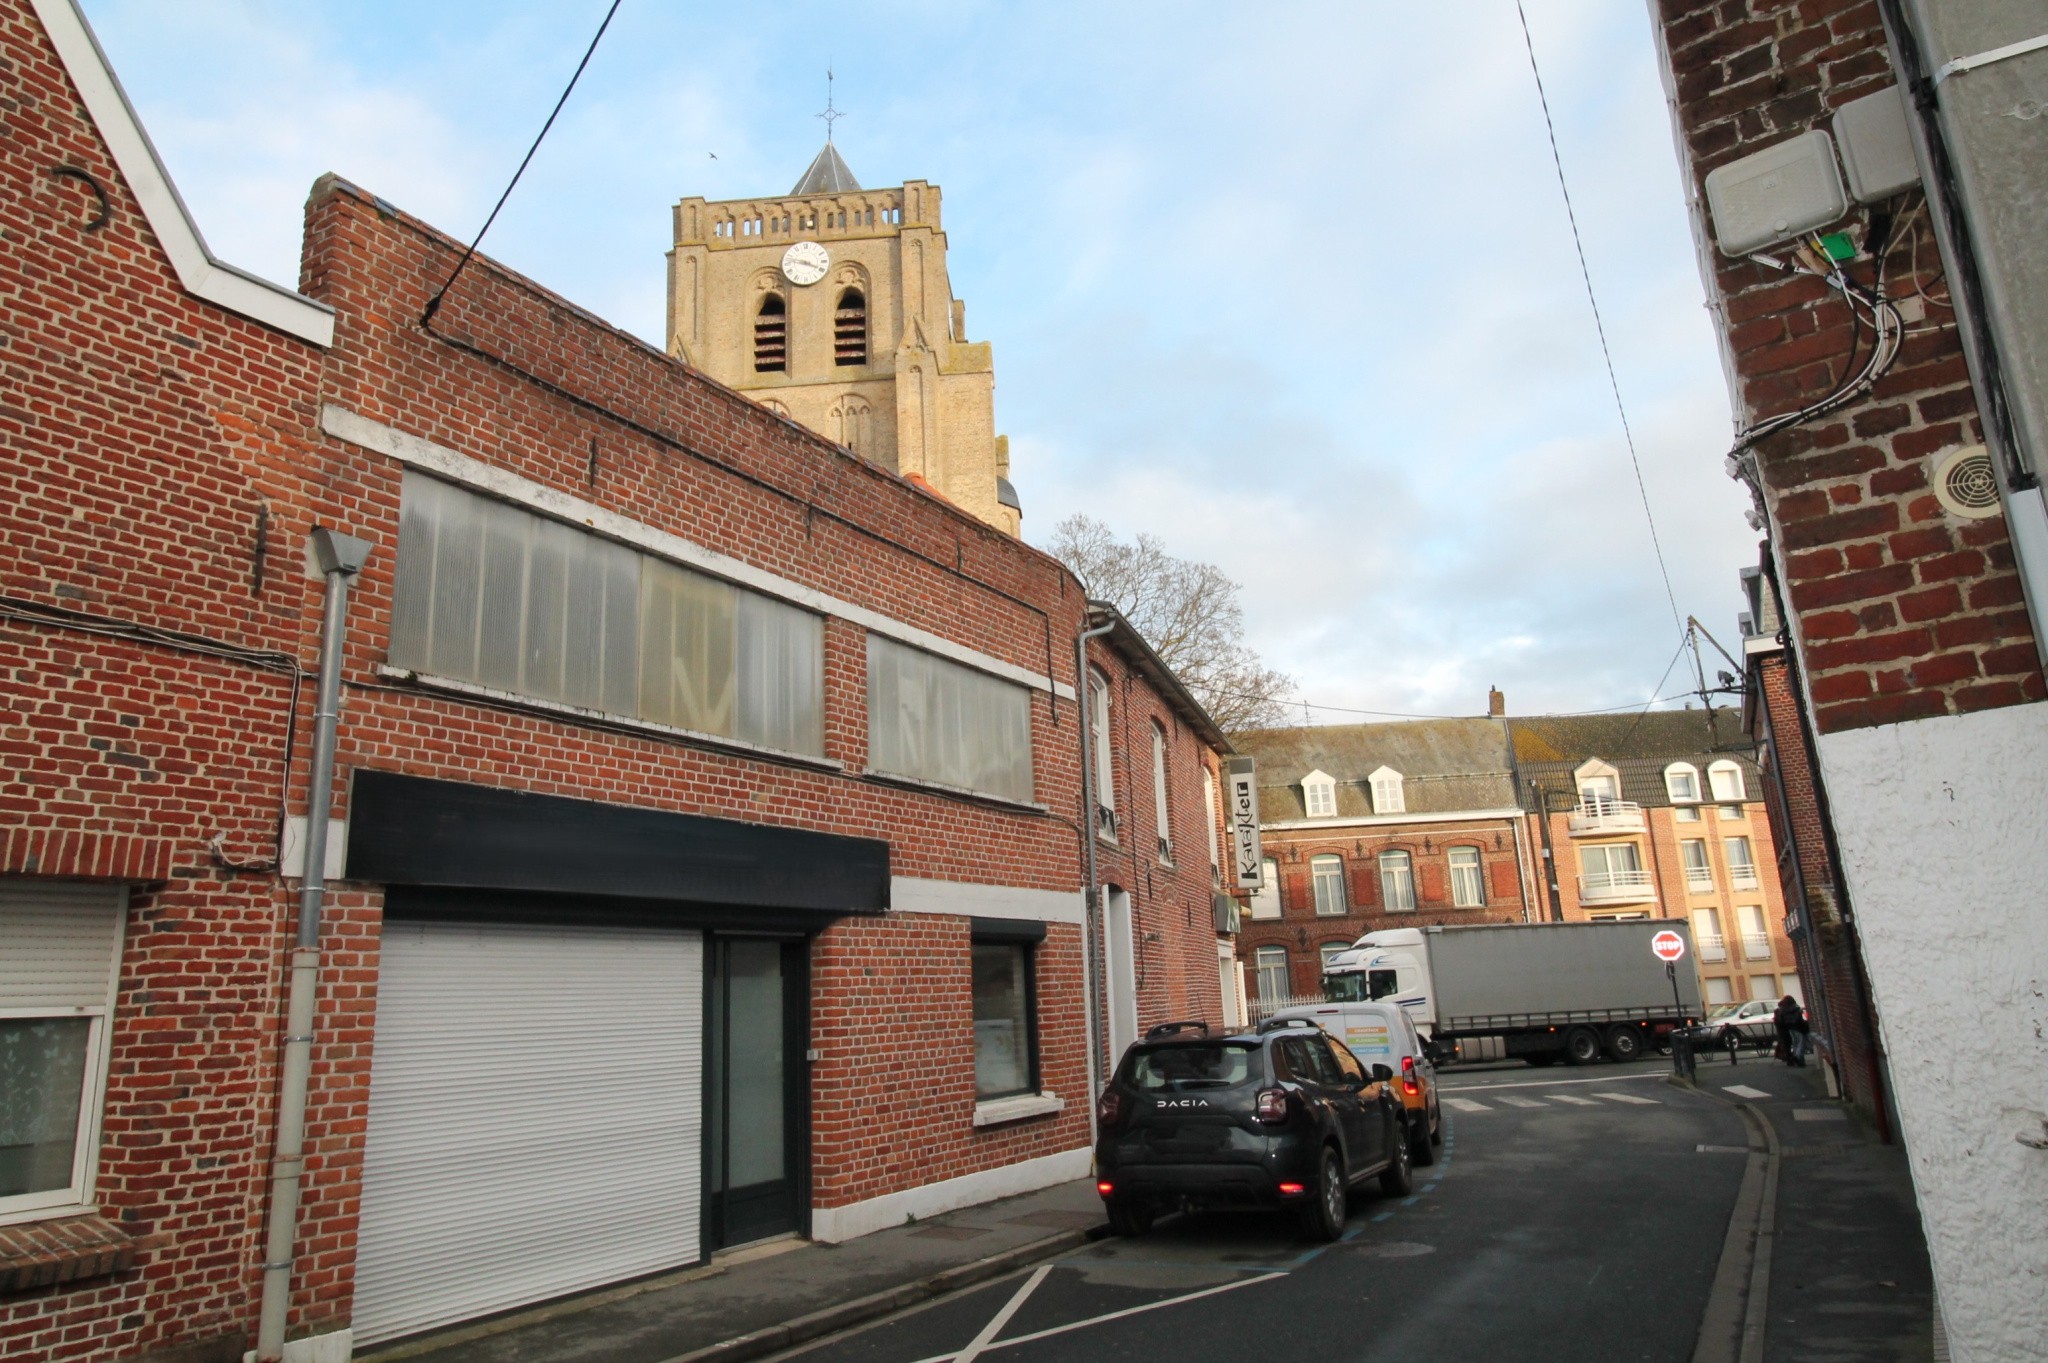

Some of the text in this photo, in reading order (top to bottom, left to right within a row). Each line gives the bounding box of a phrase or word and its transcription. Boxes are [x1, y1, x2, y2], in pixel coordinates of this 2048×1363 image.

[1235, 781, 1258, 880] Karakter
[1656, 940, 1680, 951] STOP
[1157, 1099, 1209, 1108] DACIA
